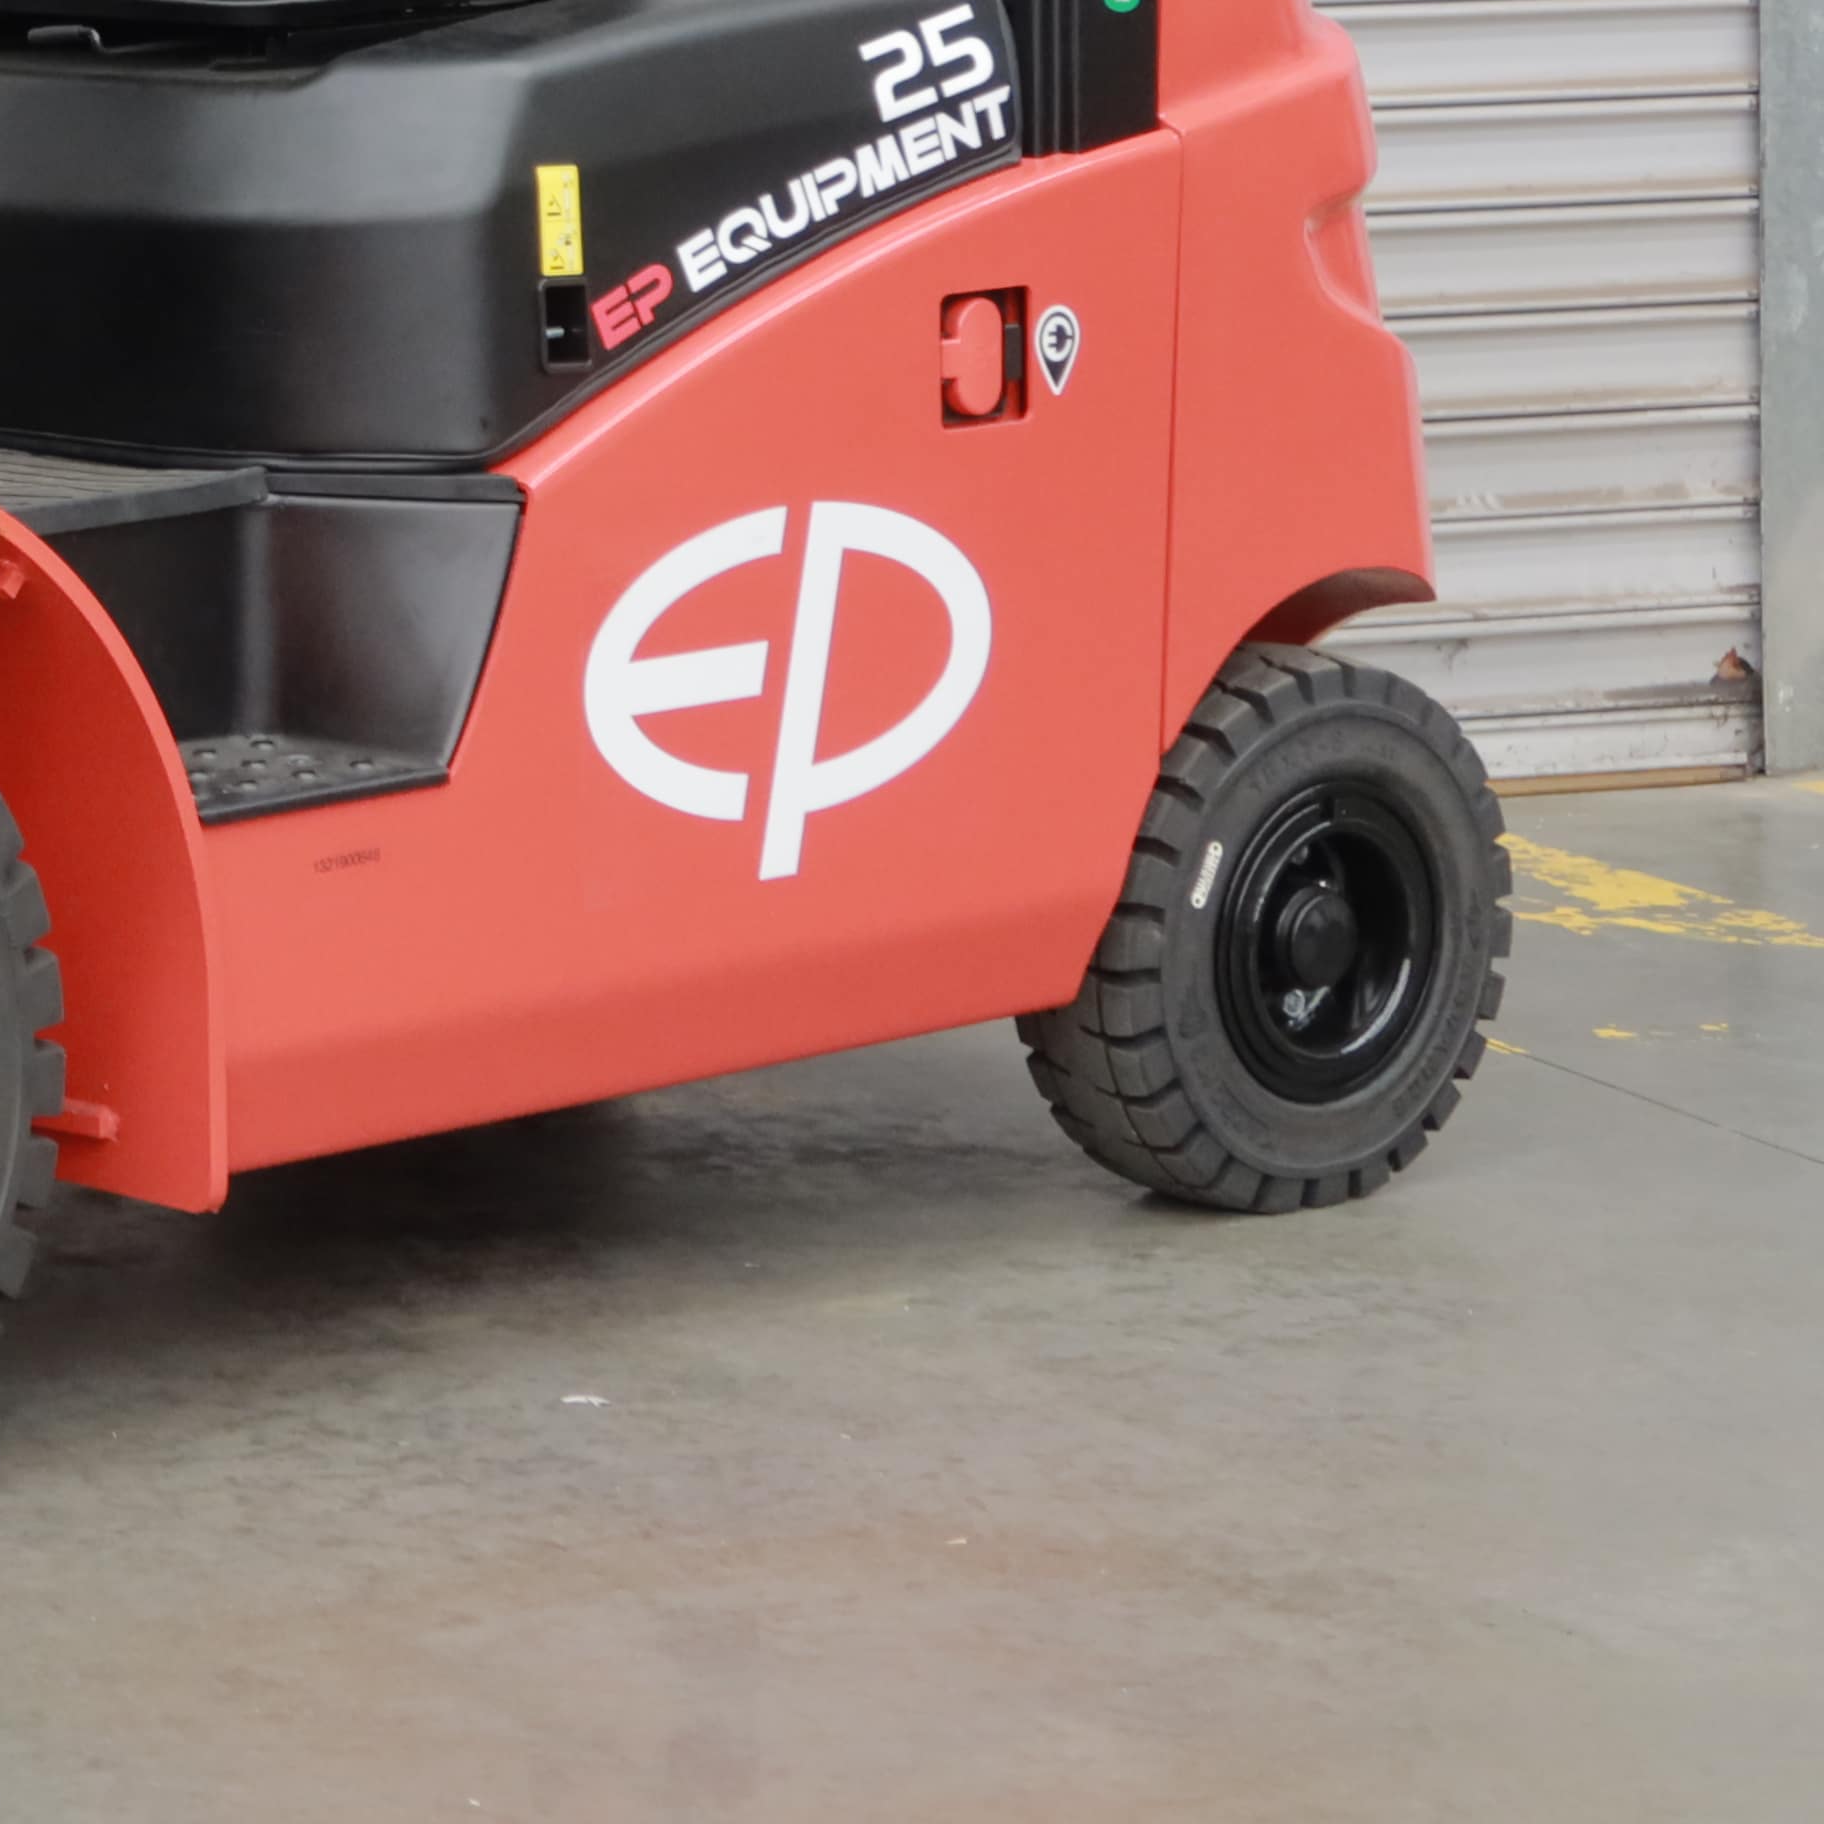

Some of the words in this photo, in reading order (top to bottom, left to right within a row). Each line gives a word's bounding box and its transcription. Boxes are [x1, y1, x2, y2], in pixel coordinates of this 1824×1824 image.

[858, 3, 995, 123] 25
[590, 263, 673, 350] EP
[676, 85, 1011, 293] EQUIPMENT
[584, 501, 992, 881] EP
